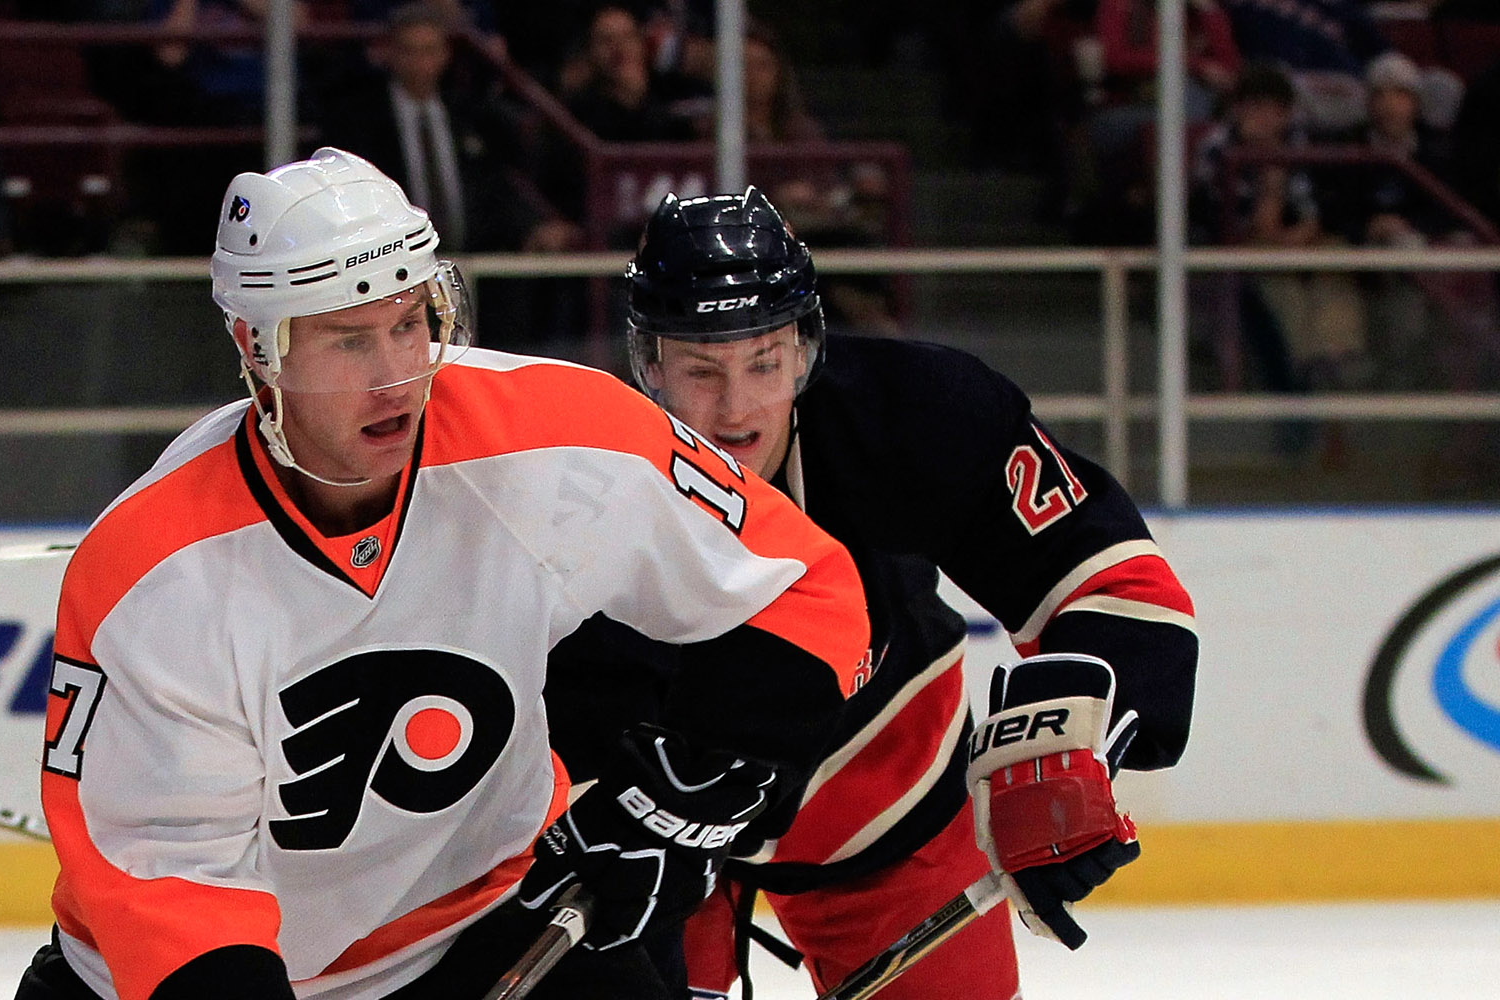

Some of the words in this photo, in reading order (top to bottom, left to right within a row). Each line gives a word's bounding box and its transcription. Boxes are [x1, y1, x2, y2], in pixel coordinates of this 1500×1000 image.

[345, 239, 405, 269] BAUER
[696, 294, 760, 313] CCM
[968, 708, 1071, 764] UER
[616, 785, 750, 849] BAUER
[558, 910, 579, 924] 17
